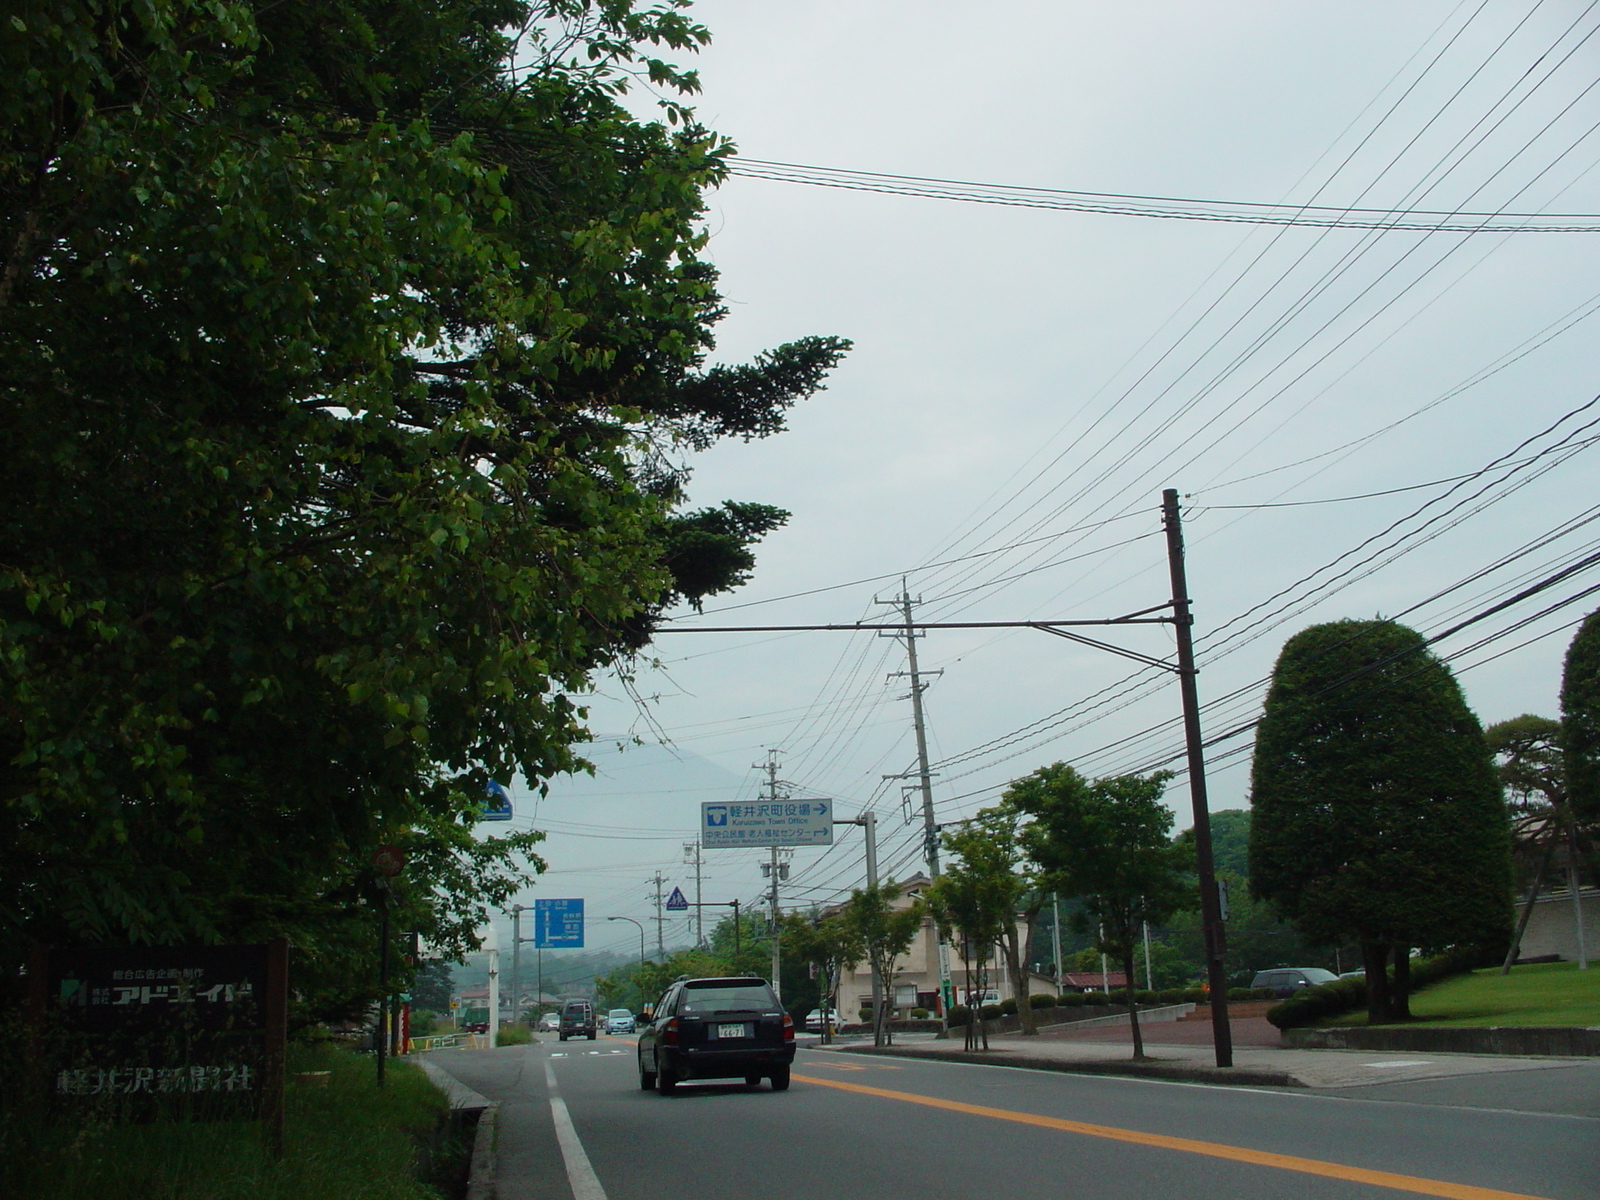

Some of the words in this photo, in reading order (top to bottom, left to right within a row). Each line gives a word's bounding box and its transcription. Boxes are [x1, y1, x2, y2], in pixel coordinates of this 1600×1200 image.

[730, 804, 811, 817] 軽井沢町役場
[788, 817, 809, 825] Office
